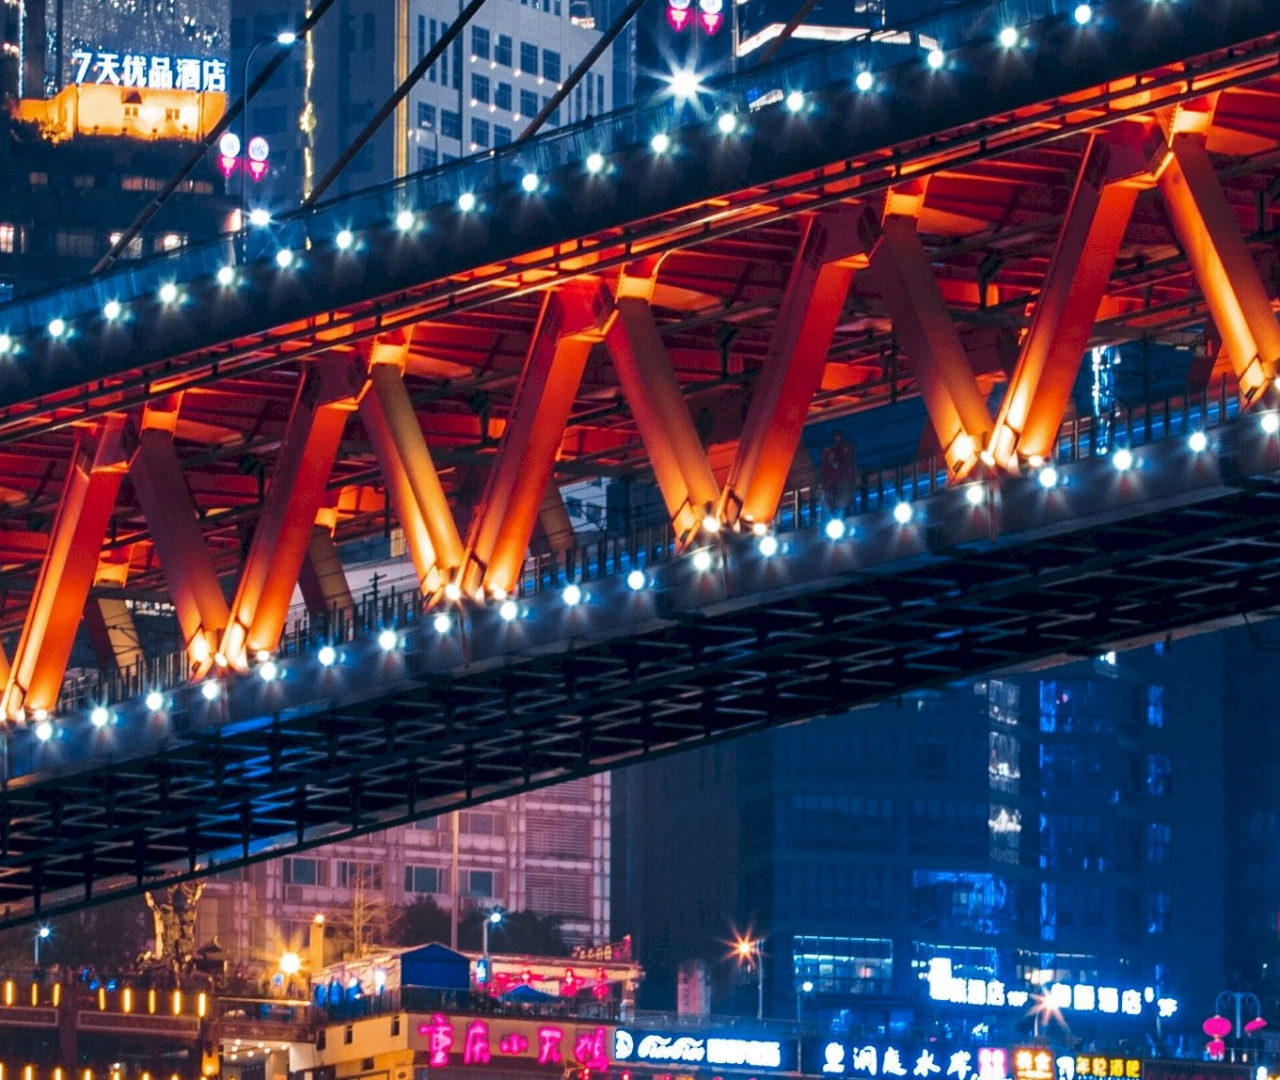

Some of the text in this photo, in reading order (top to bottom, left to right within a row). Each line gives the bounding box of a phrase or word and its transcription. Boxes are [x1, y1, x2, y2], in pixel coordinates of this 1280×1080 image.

[71, 50, 227, 92] 7天优品酒店
